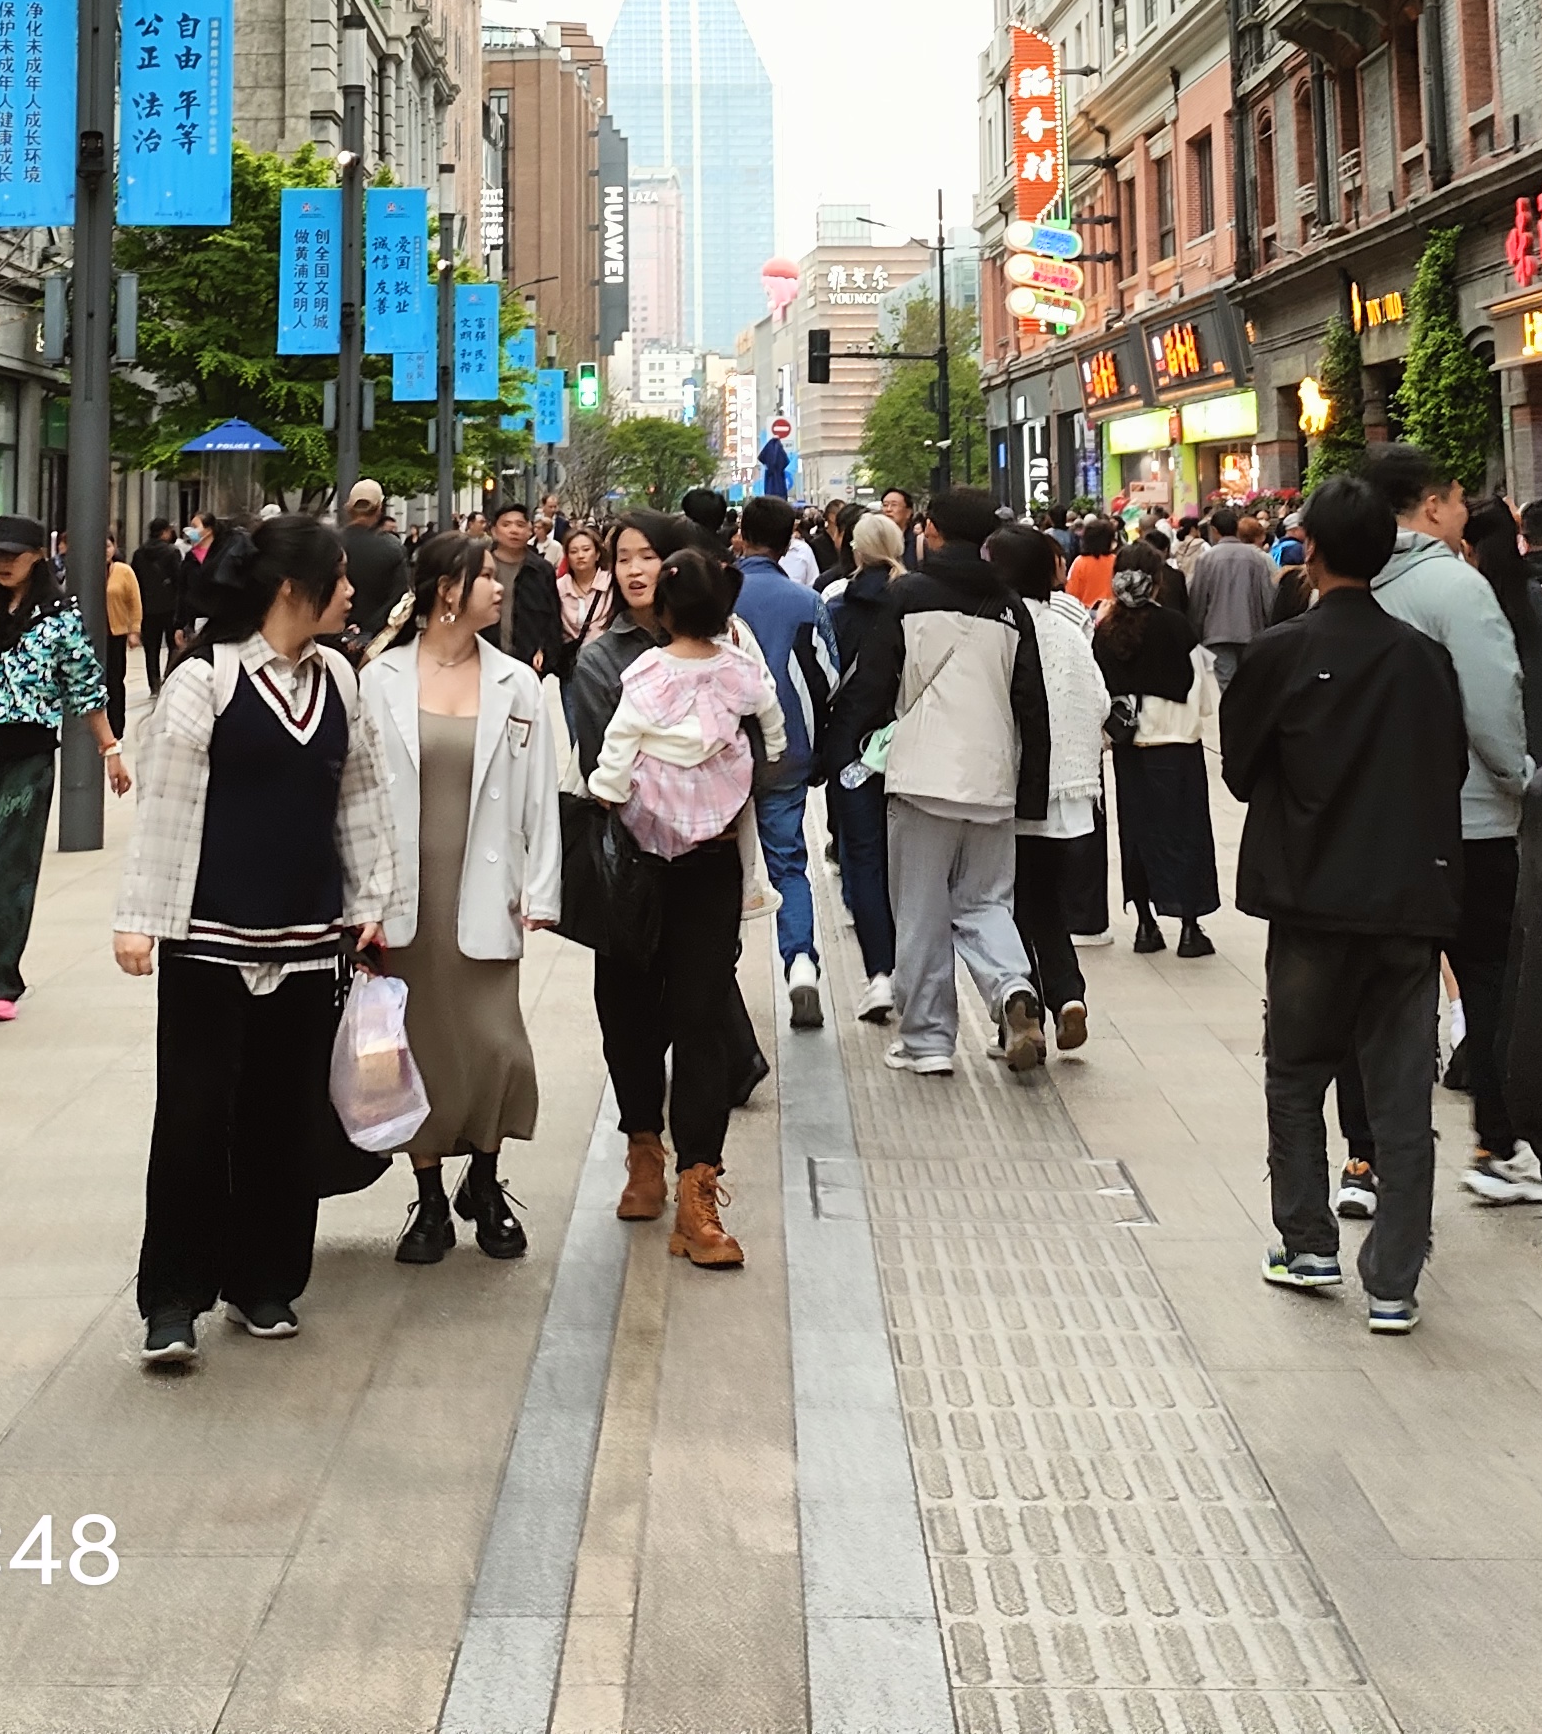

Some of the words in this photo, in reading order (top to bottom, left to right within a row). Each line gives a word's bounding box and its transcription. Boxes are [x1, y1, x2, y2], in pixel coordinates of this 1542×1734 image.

[134, 13, 164, 71] 公正
[174, 12, 203, 71] 自由
[23, 1, 45, 184] 净化未成年人成长环境
[132, 91, 164, 155] 法治
[171, 89, 203, 156] 平等
[629, 191, 658, 203] LAZA
[371, 236, 391, 270] 诚信
[395, 235, 411, 270] 爱国
[604, 186, 624, 283] HUAWEI
[293, 228, 310, 329] 做黄浦文明人
[313, 228, 330, 329] 创全国文明城
[373, 279, 390, 315] 友善
[393, 280, 413, 314] 敬业
[827, 264, 889, 293] 雅戈尔
[828, 292, 884, 304] YOUNGO
[216, 443, 250, 451] POLICE
